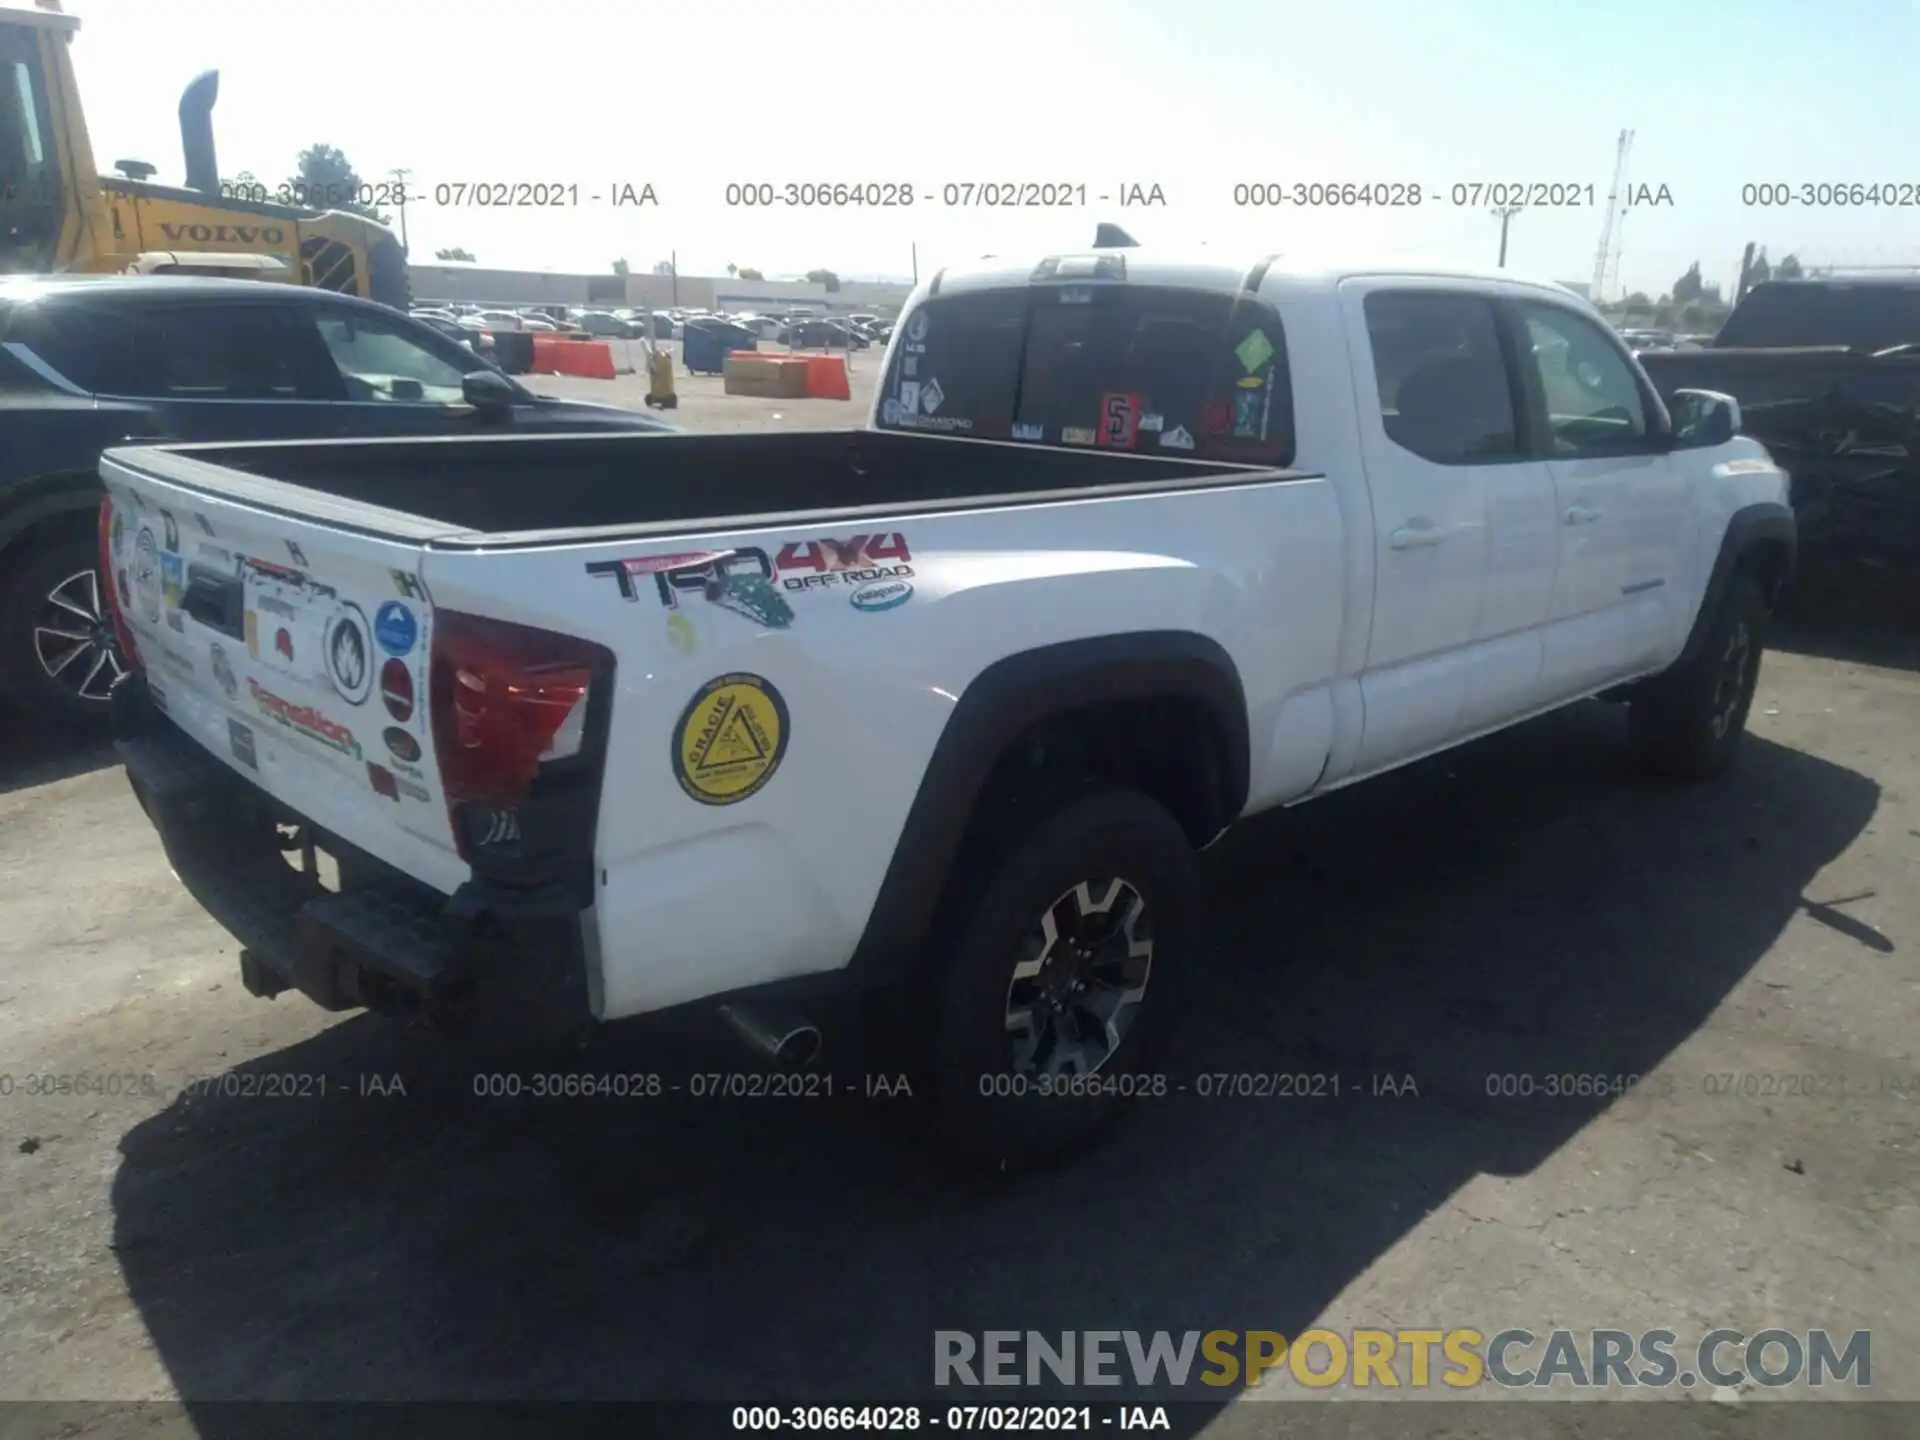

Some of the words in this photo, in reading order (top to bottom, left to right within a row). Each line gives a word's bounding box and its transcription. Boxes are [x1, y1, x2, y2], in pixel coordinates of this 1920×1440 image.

[157, 223, 283, 244] VOLVO
[783, 573, 838, 593] OFF
[842, 563, 915, 585] ROAD
[688, 695, 730, 762] GRACIE
